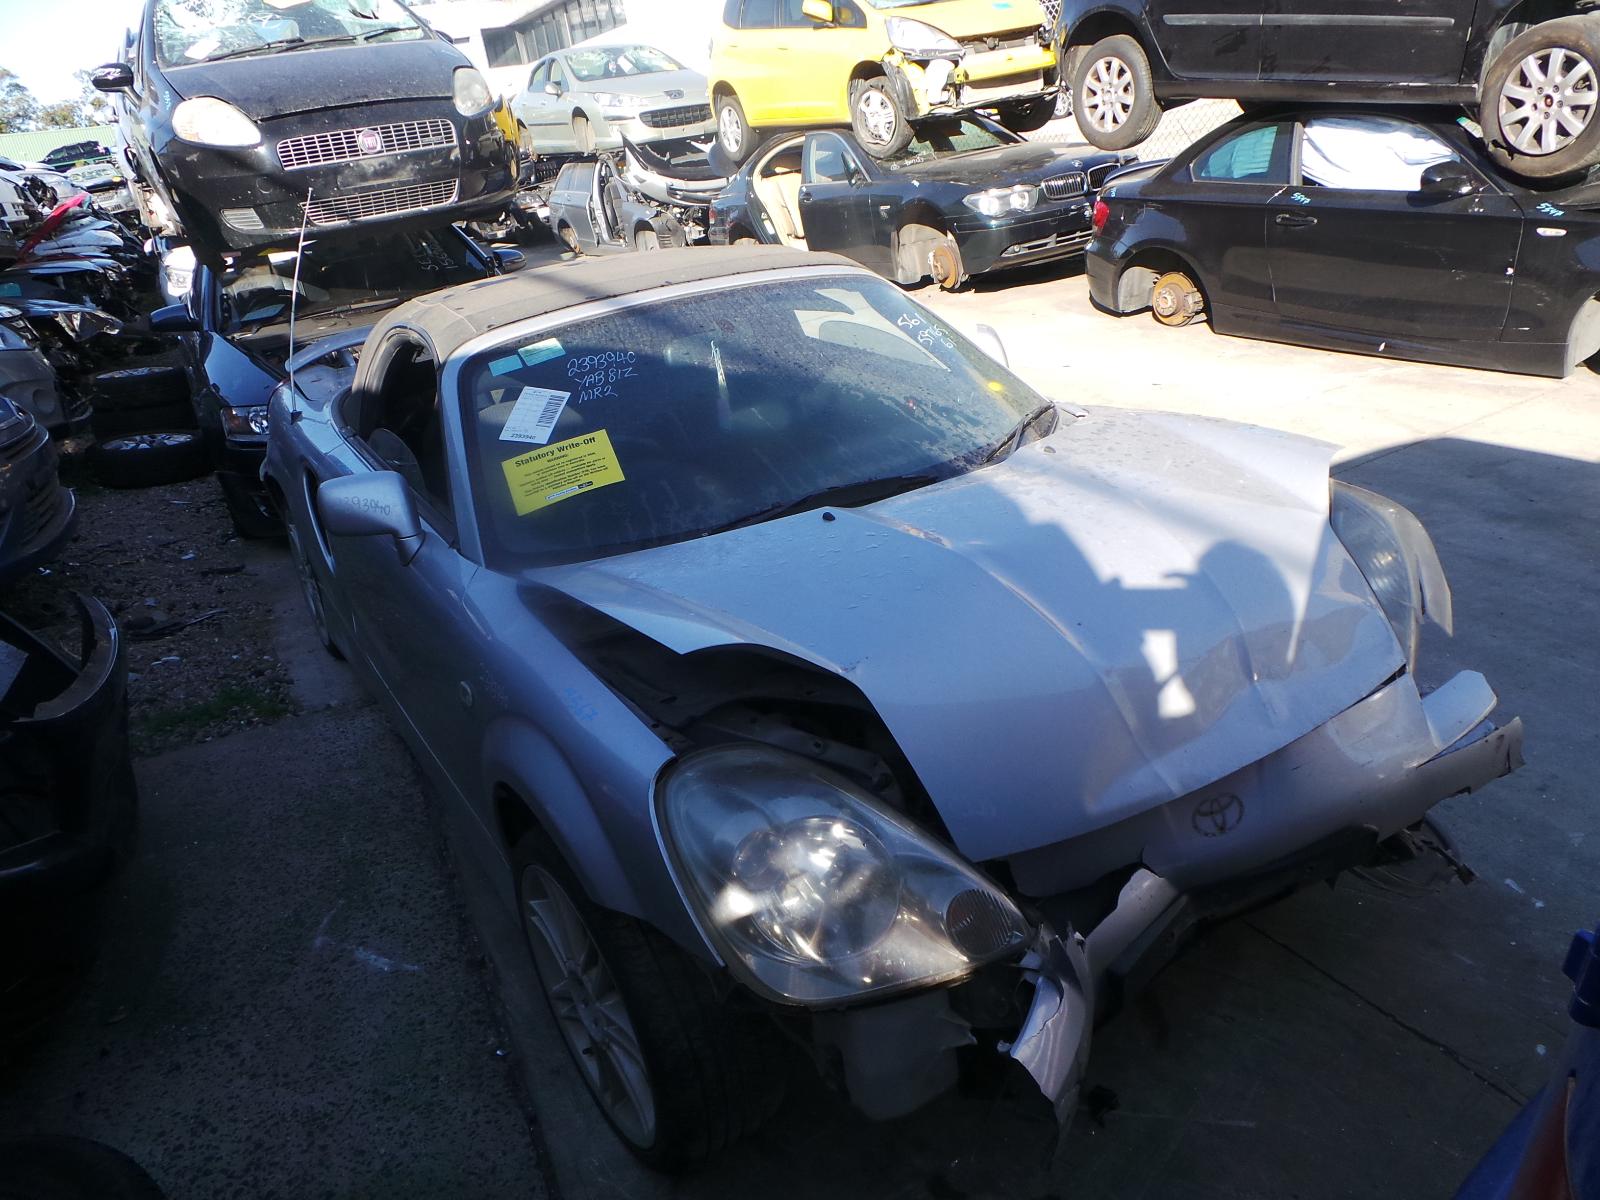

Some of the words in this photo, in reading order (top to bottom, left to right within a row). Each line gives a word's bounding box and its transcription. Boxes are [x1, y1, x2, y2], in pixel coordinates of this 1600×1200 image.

[567, 351, 636, 377] 2393940
[574, 370, 605, 390] YAB
[578, 385, 618, 404] MR2
[515, 447, 556, 468] Statutory
[557, 436, 596, 453] Write-Off
